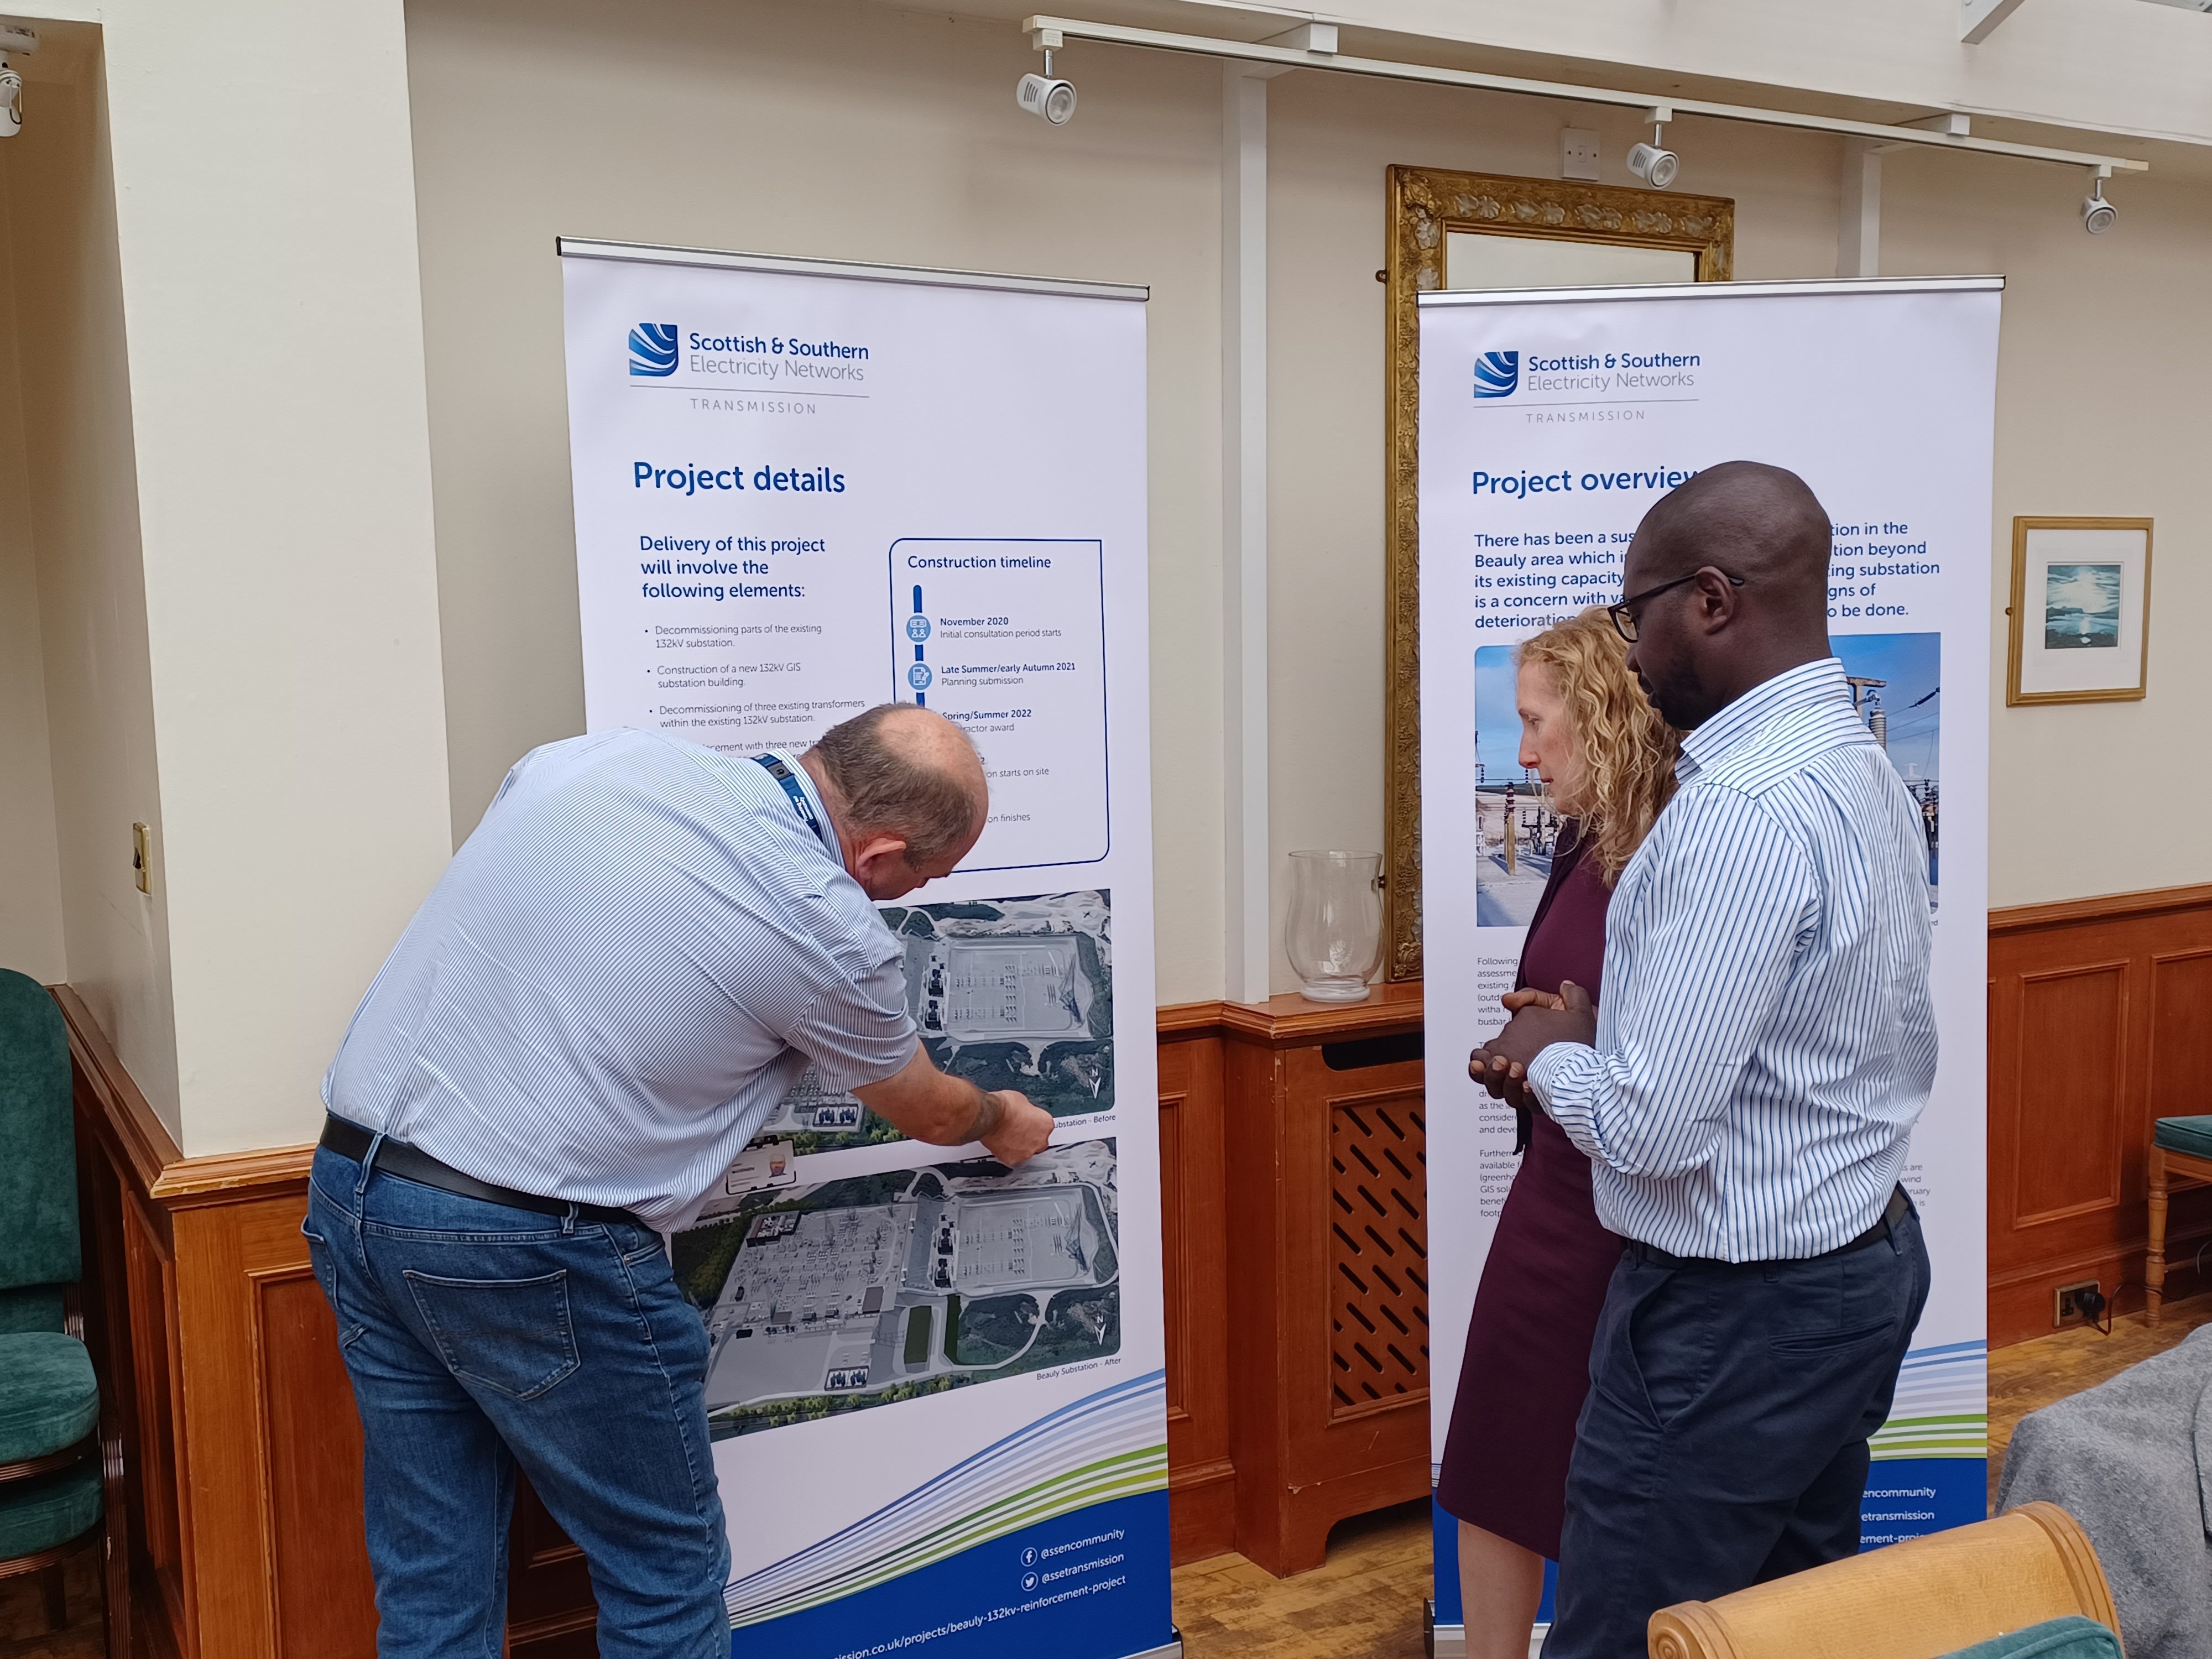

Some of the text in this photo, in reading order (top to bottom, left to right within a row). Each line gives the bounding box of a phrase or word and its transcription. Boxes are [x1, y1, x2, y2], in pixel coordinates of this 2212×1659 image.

[690, 333, 869, 359] Scottish & Southern
[690, 355, 864, 381] Electricity Networks
[1528, 353, 1700, 371] Scottish & Southern
[1528, 372, 1694, 392] Electricity Networks
[690, 398, 816, 414] TRANSMISSION
[1527, 410, 1645, 423] TRANSMISSION
[634, 462, 846, 496] Project details
[1473, 470, 1572, 499] Project
[1831, 521, 1908, 536] tion in the
[640, 536, 826, 555] Delivery of this project
[1474, 534, 1519, 547] There
[1524, 533, 1550, 545] has
[1555, 532, 1593, 544] been
[1598, 534, 1606, 543] a
[1834, 541, 1926, 558] tion beyond
[908, 556, 1051, 568] Construction timeline
[1475, 554, 1526, 569] Beauly
[1531, 555, 1563, 565] area
[1569, 550, 1615, 564] which
[641, 560, 769, 575] will involve the
[1860, 561, 1940, 576] substation
[1475, 571, 1625, 588] its existing capacity
[642, 583, 805, 601] following elements:
[1475, 595, 1486, 608] is
[1491, 597, 1499, 607] a
[1504, 595, 1568, 607] concern
[1573, 591, 1606, 605] with
[1828, 583, 1876, 601] gns of
[1827, 603, 1908, 618] o be done.
[940, 617, 1009, 626] November 2020
[655, 624, 822, 636] Decommissioning parts of the existing
[940, 629, 1062, 639] Initial consultation period starts
[656, 639, 684, 648] 132kV
[658, 662, 801, 675] Construction of a new 132kV GIS
[941, 662, 1076, 674] Late Summer/early Autumn 2021
[658, 678, 706, 688] substation
[942, 677, 1024, 687] Planning submission
[660, 699, 865, 715] Decommissioning of three existing transformers
[1011, 709, 1031, 718] 2022
[660, 718, 689, 728] within
[691, 718, 706, 727] the
[708, 717, 742, 728] existing
[744, 716, 768, 726] 132kV
[990, 723, 1014, 732] award
[745, 742, 763, 750] with
[765, 739, 787, 749] three
[1000, 769, 1021, 777] starts
[1036, 767, 1049, 775] site
[1001, 813, 1030, 822] finishes
[1478, 957, 1518, 966] Following
[1478, 982, 1509, 990] existing
[1054, 1118, 1087, 1129] ubstation
[1094, 1114, 1116, 1123] Before
[1480, 1173, 1516, 1183] (greenho
[1480, 1185, 1494, 1193] GIS
[1036, 1370, 1060, 1380] Beauly
[1061, 1362, 1098, 1375] Substation
[1104, 1358, 1121, 1366] After
[1863, 1487, 1936, 1499] encommunity
[1861, 1511, 1935, 1521] etransmission
[1041, 1529, 1125, 1559] @ssencommunity
[1041, 1554, 1124, 1584] @ssetransmission
